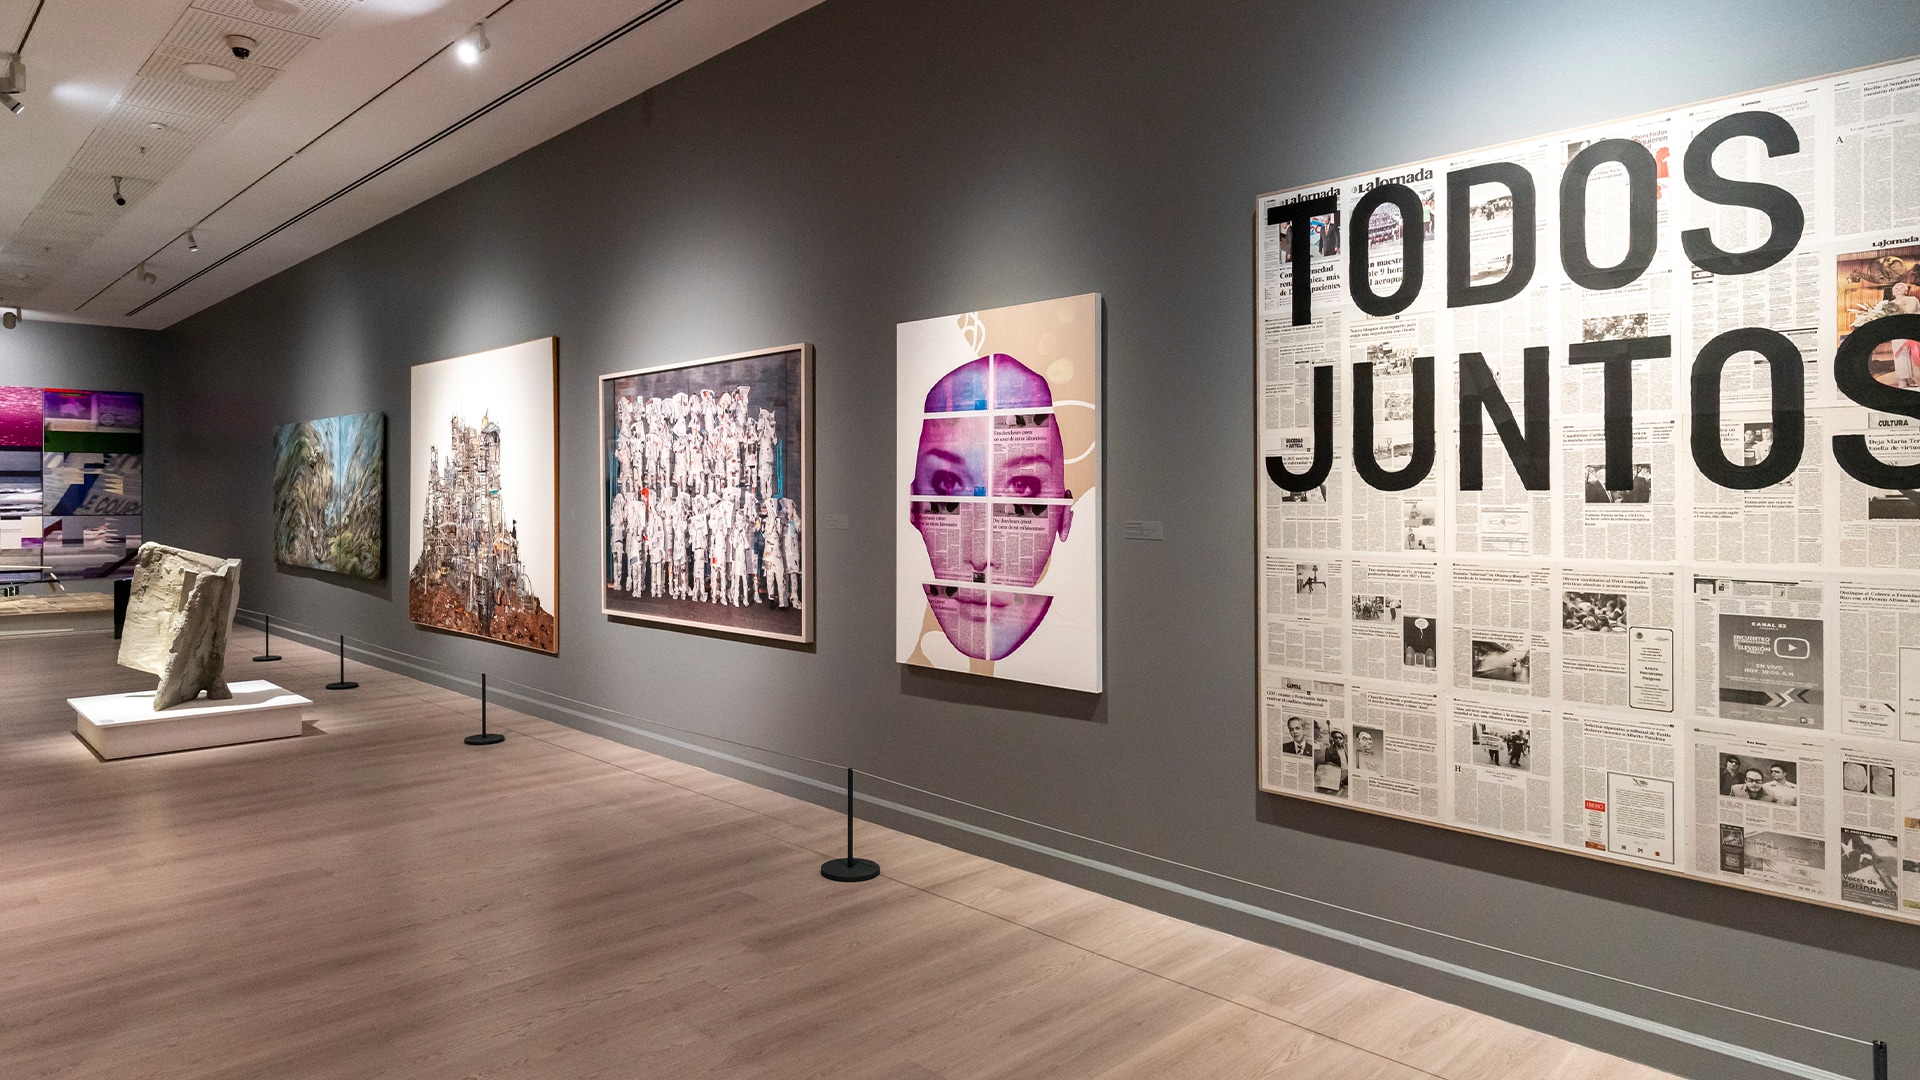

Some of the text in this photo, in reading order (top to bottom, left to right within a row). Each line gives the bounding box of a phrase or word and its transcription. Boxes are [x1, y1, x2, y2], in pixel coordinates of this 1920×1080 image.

[1835, 136, 1844, 144] A
[1266, 111, 1804, 326] TODOS
[1377, 257, 1402, 267] maestr
[1310, 264, 1334, 274] rmedad
[1374, 276, 1403, 285] aeropue
[1311, 283, 1341, 293] pacientes
[1266, 314, 1920, 492] JUNTOS
[1878, 419, 1909, 427] CULTURA
[1734, 644, 1771, 652] TELEVISIÓN
[1843, 875, 1865, 883] Voces
[1842, 880, 1897, 896] Borinquen
